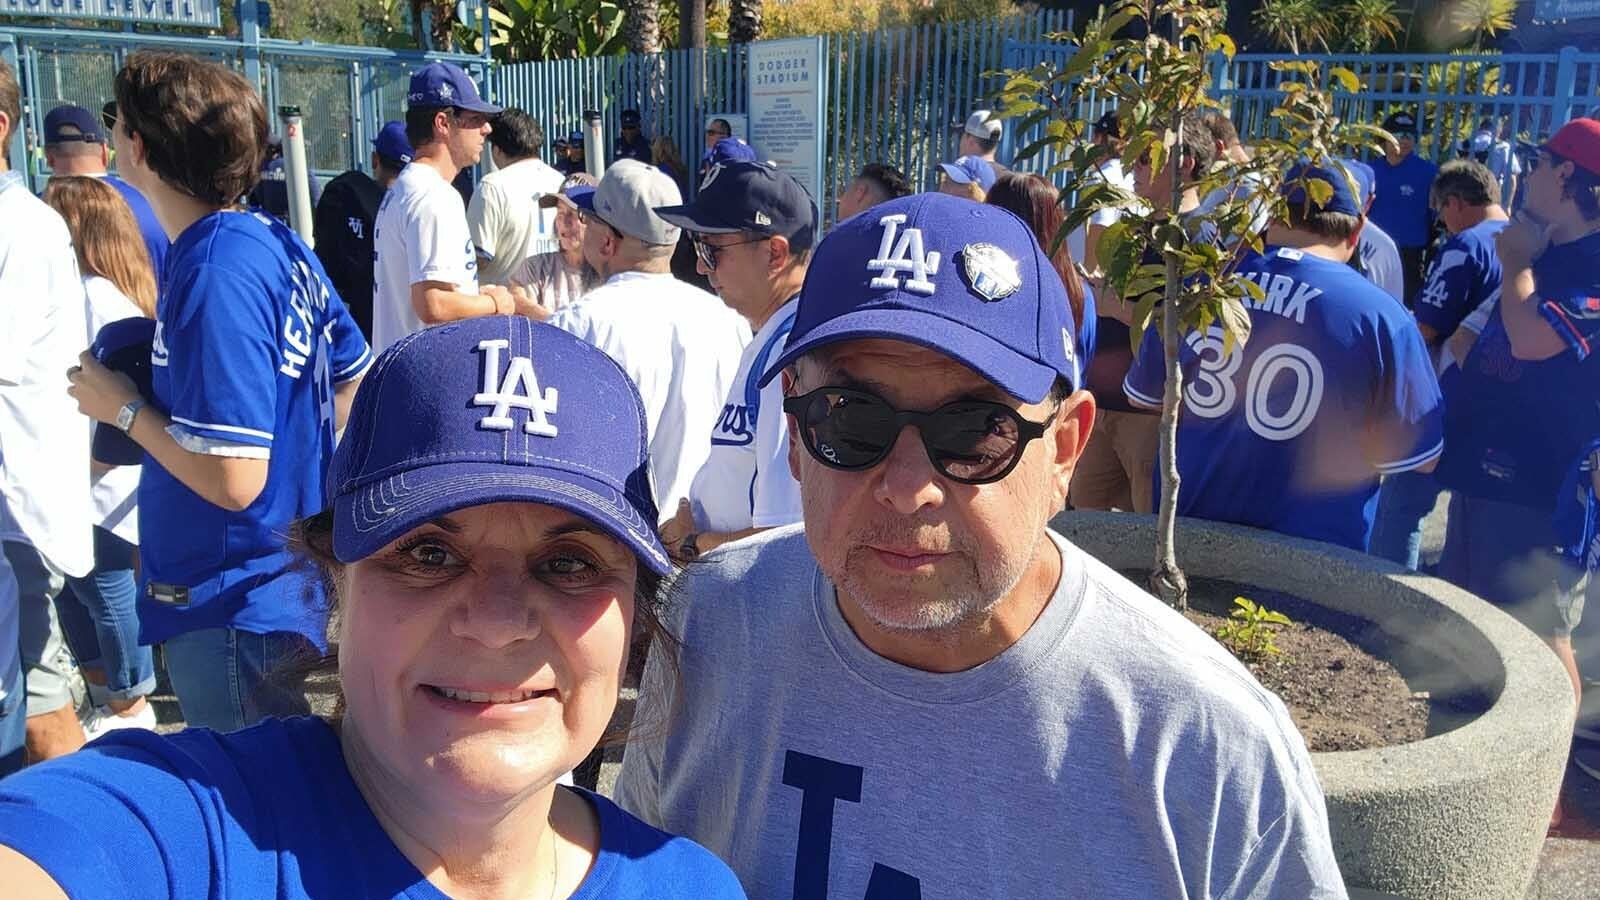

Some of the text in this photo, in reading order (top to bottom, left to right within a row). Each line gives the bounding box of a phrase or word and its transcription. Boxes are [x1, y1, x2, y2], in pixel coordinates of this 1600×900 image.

[106, 0, 193, 17] LEVEL
[757, 71, 809, 85] STADIUM
[759, 58, 807, 71] DODGER
[866, 214, 942, 296] LA
[1236, 271, 1323, 324] KIRK
[473, 339, 559, 437] LA
[1184, 325, 1324, 441] 30
